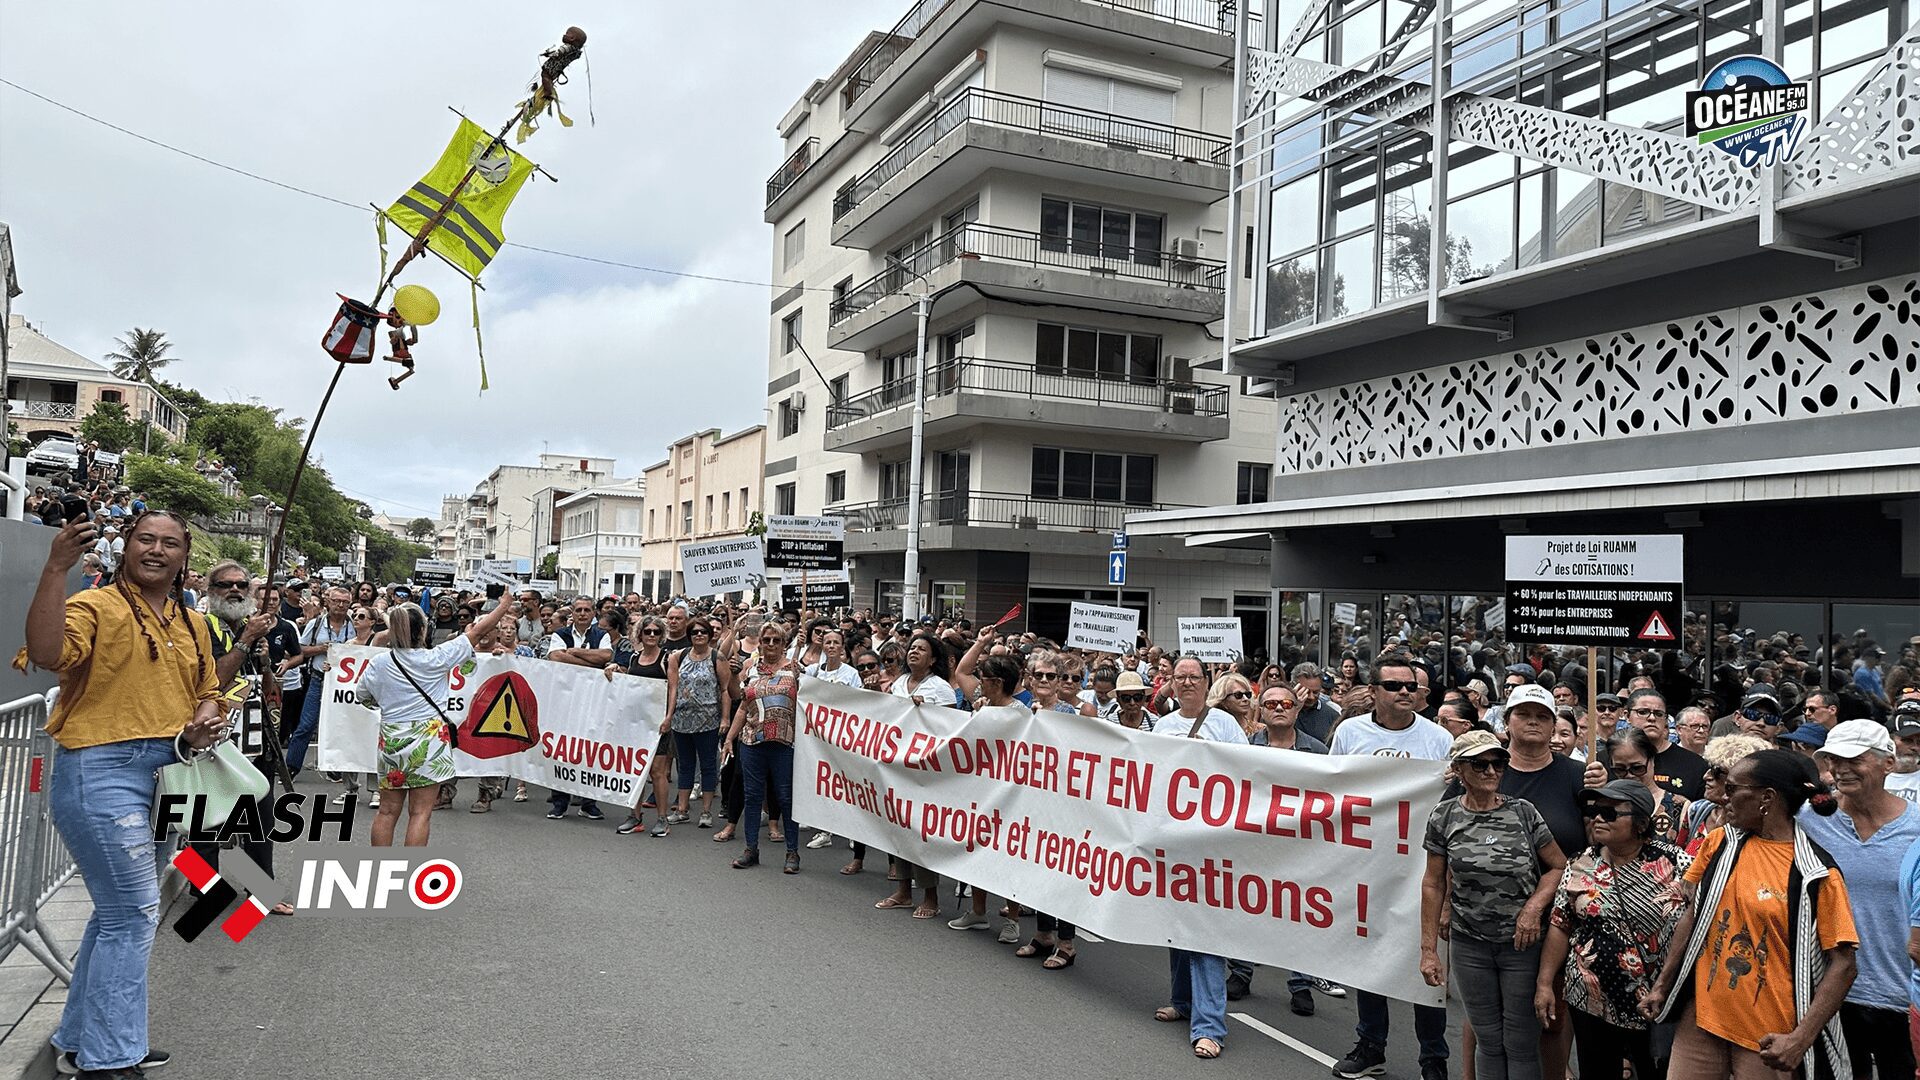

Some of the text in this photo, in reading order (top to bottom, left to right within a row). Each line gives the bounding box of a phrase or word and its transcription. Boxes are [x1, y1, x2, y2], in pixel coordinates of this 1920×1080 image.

[684, 548, 706, 558] SAUVER
[707, 546, 719, 555] NOS
[781, 541, 794, 550] STOP
[1548, 541, 1636, 556] Projet de Loi RUAMM
[694, 558, 745, 573] C'EST SAUVER NOS
[1554, 564, 1570, 576] des
[1572, 564, 1628, 576] COTISATIONS
[710, 576, 738, 587] SALAIRES
[1520, 589, 1530, 598] 60
[1538, 591, 1554, 601] pour
[1556, 589, 1566, 600] les
[1566, 590, 1617, 600] TRAVAILLEURS
[1618, 590, 1672, 602] INDEPENDANTS
[1520, 606, 1530, 616] 29
[1538, 608, 1554, 618] pour
[1556, 607, 1566, 617] les
[1567, 608, 1612, 618] ENTREPRISES
[1083, 622, 1115, 633] TRAVAILLEURS
[1520, 624, 1528, 634] 12
[1537, 626, 1552, 636] pour
[1554, 624, 1564, 634] les
[1566, 625, 1630, 638] ADMINISTRATIONS
[542, 732, 649, 776] SAUVONS
[554, 764, 630, 794] NOS EMPLOIS
[804, 702, 902, 764] ARTISANS
[904, 732, 944, 772] EN
[948, 737, 1059, 792] DANGER
[1066, 750, 1102, 800] ET
[1106, 757, 1154, 812] EN
[1167, 768, 1372, 850] COLERE
[816, 760, 882, 818] Retrait
[883, 788, 912, 830] du
[922, 802, 1002, 852] projet
[1006, 816, 1030, 860] et
[1034, 830, 1333, 928] renégociations
